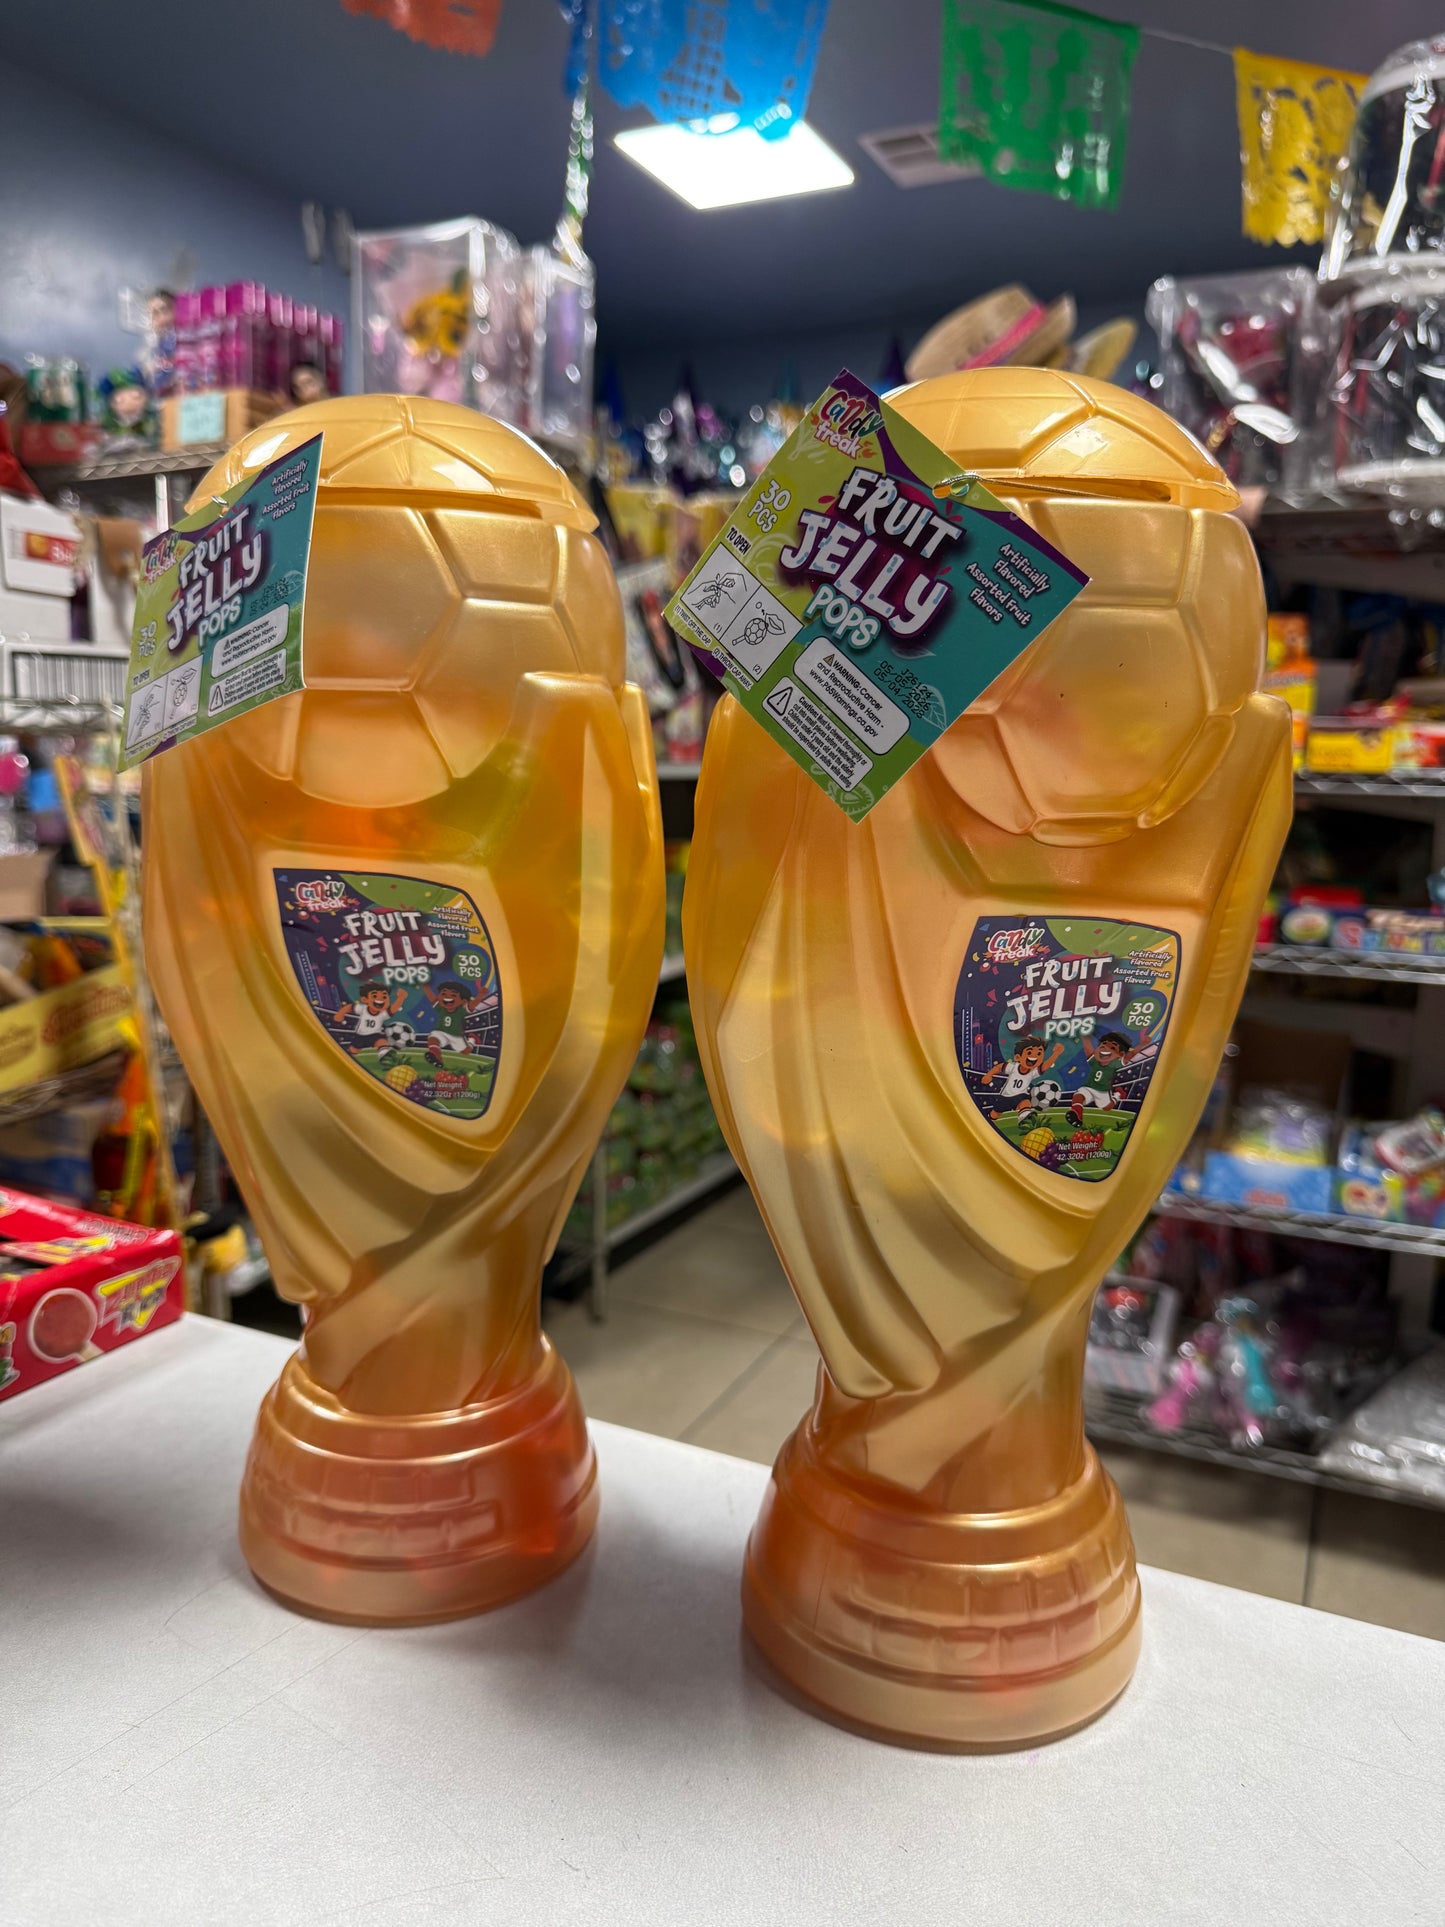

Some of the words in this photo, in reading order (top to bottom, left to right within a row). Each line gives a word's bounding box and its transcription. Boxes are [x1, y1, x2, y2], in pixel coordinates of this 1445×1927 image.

[813, 421, 864, 460] freak
[272, 460, 308, 485] Artificially
[274, 474, 302, 495] Flavored
[262, 492, 292, 514] Assorted
[293, 483, 310, 498] Fruit
[759, 480, 792, 512] 30
[272, 502, 296, 519] Flavors
[747, 499, 779, 533] PCS
[839, 468, 964, 559] FRUIT
[179, 507, 250, 589] FRUIT
[725, 527, 737, 542] TO
[731, 533, 751, 555] OPEN
[781, 512, 950, 635] JELLY
[994, 561, 1035, 598] Flavored
[1000, 543, 1050, 591] Artificially
[167, 533, 262, 650] JELLY
[966, 563, 1011, 603] Assorted
[1005, 599, 1030, 624] Fruit
[970, 587, 1003, 621] Flavors
[199, 596, 242, 646] POPS
[713, 622, 722, 633] (1)
[808, 586, 880, 648] POPS
[752, 663, 762, 674] (2)
[816, 660, 831, 675] and
[827, 672, 866, 712] Reproductive
[863, 707, 881, 725] Harm
[831, 659, 862, 691] WARNING:
[858, 686, 883, 712] Cancer
[872, 666, 925, 719] 05/04/2028
[879, 659, 931, 712] 05/05/2026
[901, 667, 933, 699] J26124
[808, 667, 878, 739] www.P65Warnings.ca.gov
[344, 911, 422, 938] FRUIT
[433, 906, 472, 918] Artificially
[427, 921, 460, 930] Assorted
[988, 928, 1045, 953] Candy
[338, 934, 446, 975] JELLY
[458, 955, 480, 966] 30
[994, 947, 1034, 961] freak
[1129, 951, 1172, 961] Artificially
[1130, 958, 1163, 967] Flavored
[382, 966, 430, 985] POPS
[459, 967, 482, 977] PCS
[1024, 957, 1113, 988] FRUIT
[1114, 968, 1149, 976] Assorted
[1150, 970, 1170, 978] Fruit
[1124, 976, 1151, 984] Flavors
[1006, 981, 1122, 1031] JELLY
[1129, 1002, 1155, 1015] 30
[366, 1019, 376, 1028] 10
[444, 1016, 452, 1027] 9
[1045, 1017, 1095, 1040] POPS
[1127, 1015, 1152, 1026] PCS
[1012, 1078, 1023, 1089] 10
[1094, 1071, 1102, 1082] 9
[1073, 1142, 1098, 1150] Weight:
[1086, 1151, 1112, 1159] (1200g)
